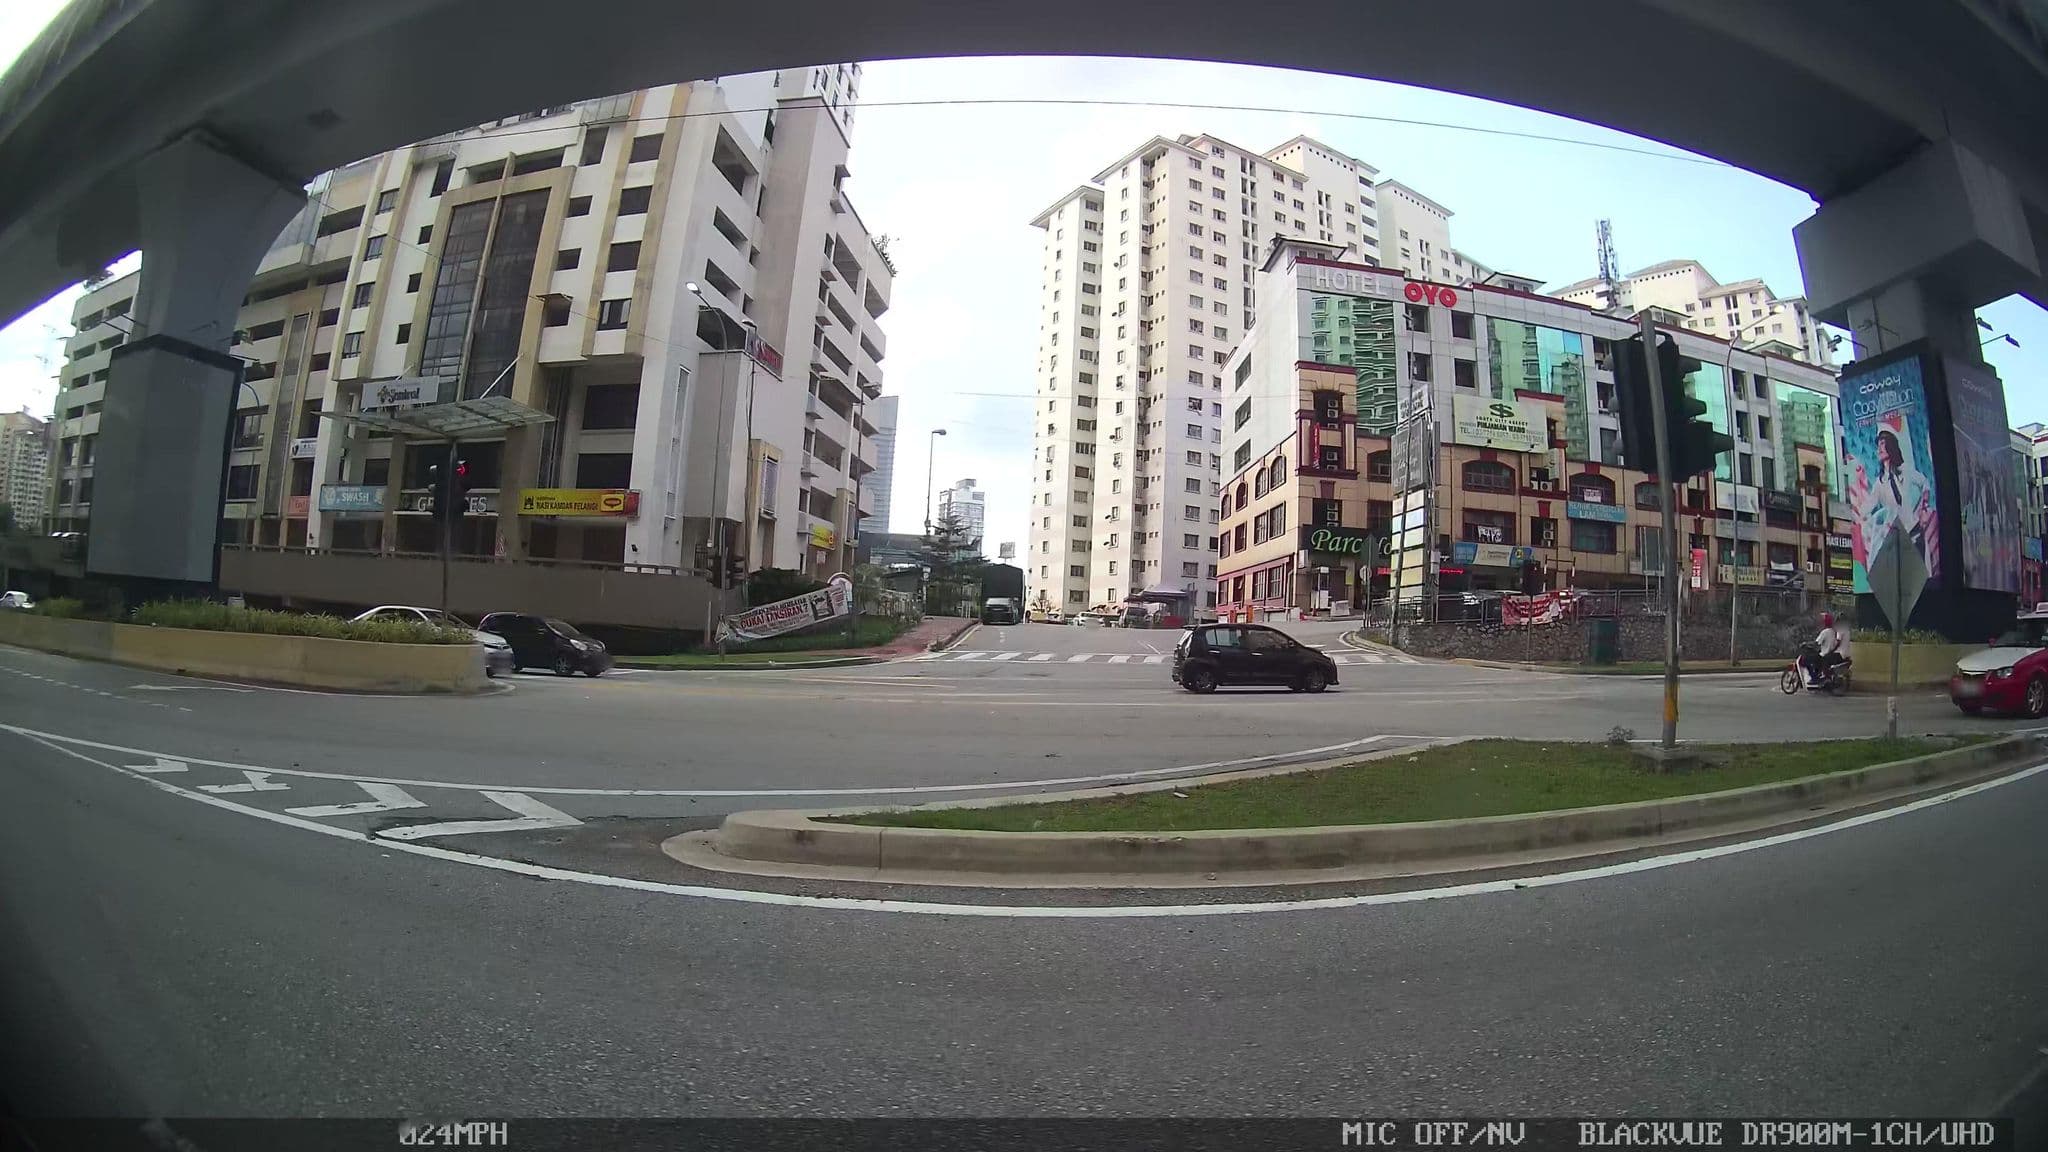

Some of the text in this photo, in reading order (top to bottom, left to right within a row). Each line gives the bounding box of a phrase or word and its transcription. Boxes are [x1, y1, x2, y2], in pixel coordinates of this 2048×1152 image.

[1315, 265, 1457, 308] HOTEL OYO
[1859, 375, 1901, 394] coway
[1311, 529, 1363, 553] Parc
[766, 606, 803, 623] TAKSIRAN
